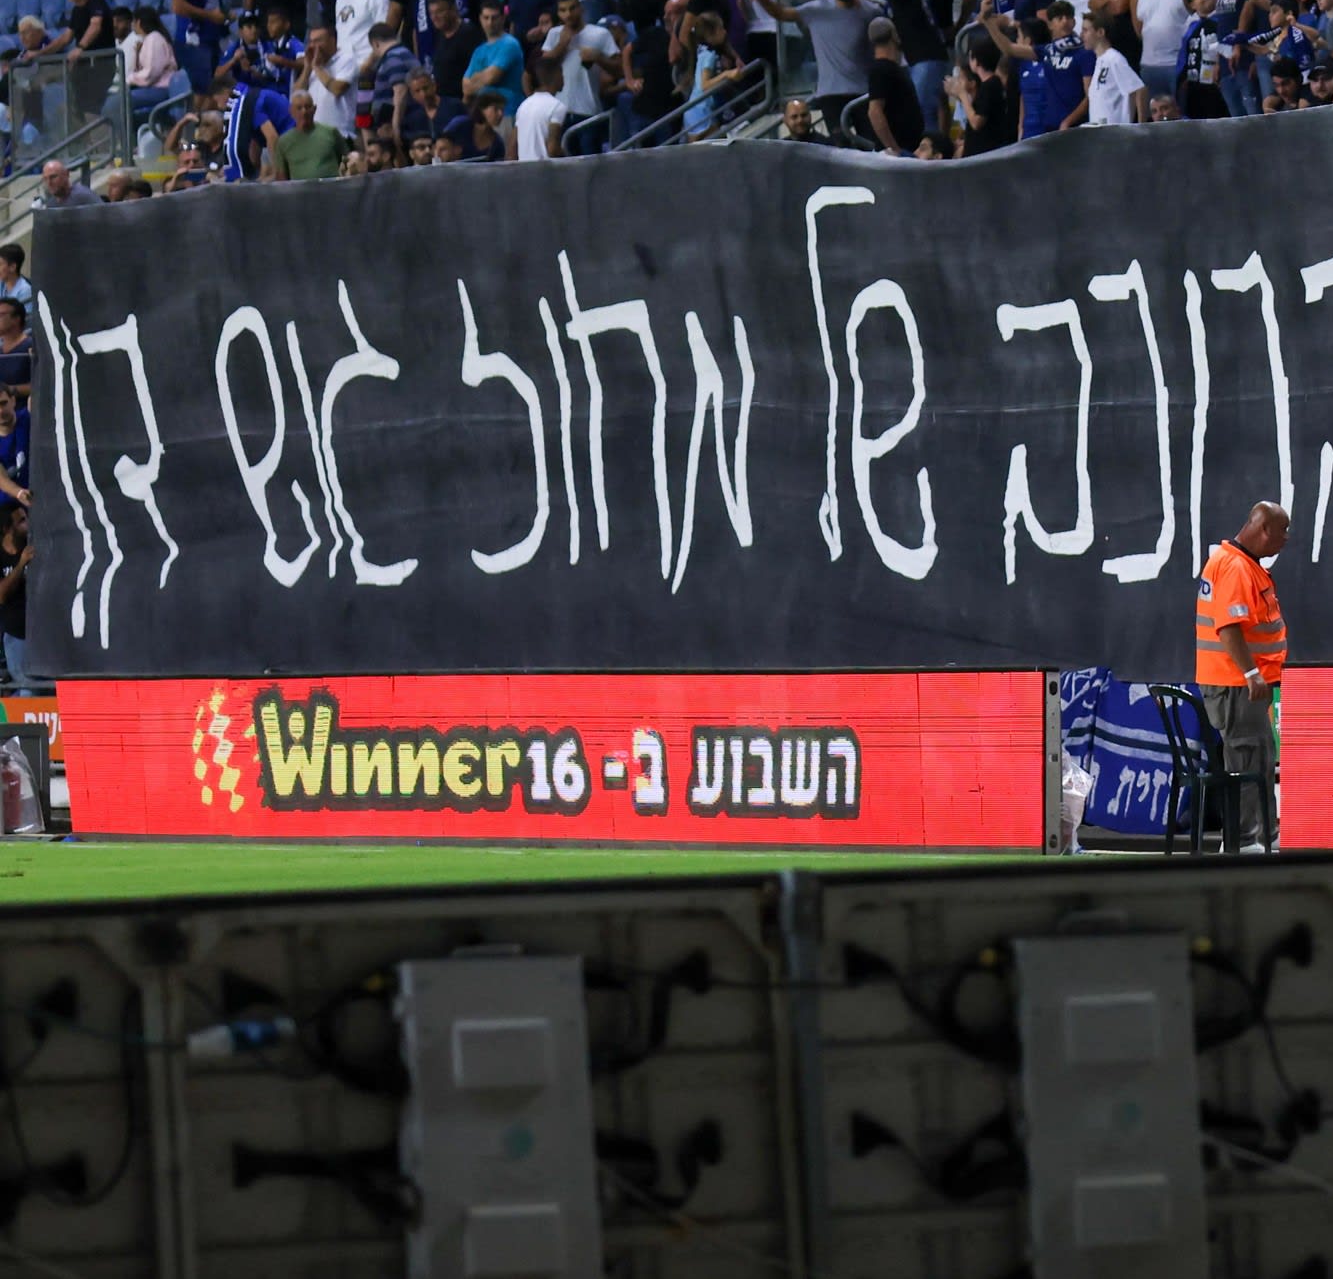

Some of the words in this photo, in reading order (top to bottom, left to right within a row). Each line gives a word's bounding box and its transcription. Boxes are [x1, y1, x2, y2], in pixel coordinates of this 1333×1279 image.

[216, 280, 417, 586] גוש
[806, 187, 938, 579] של
[692, 736, 856, 806] השבוע
